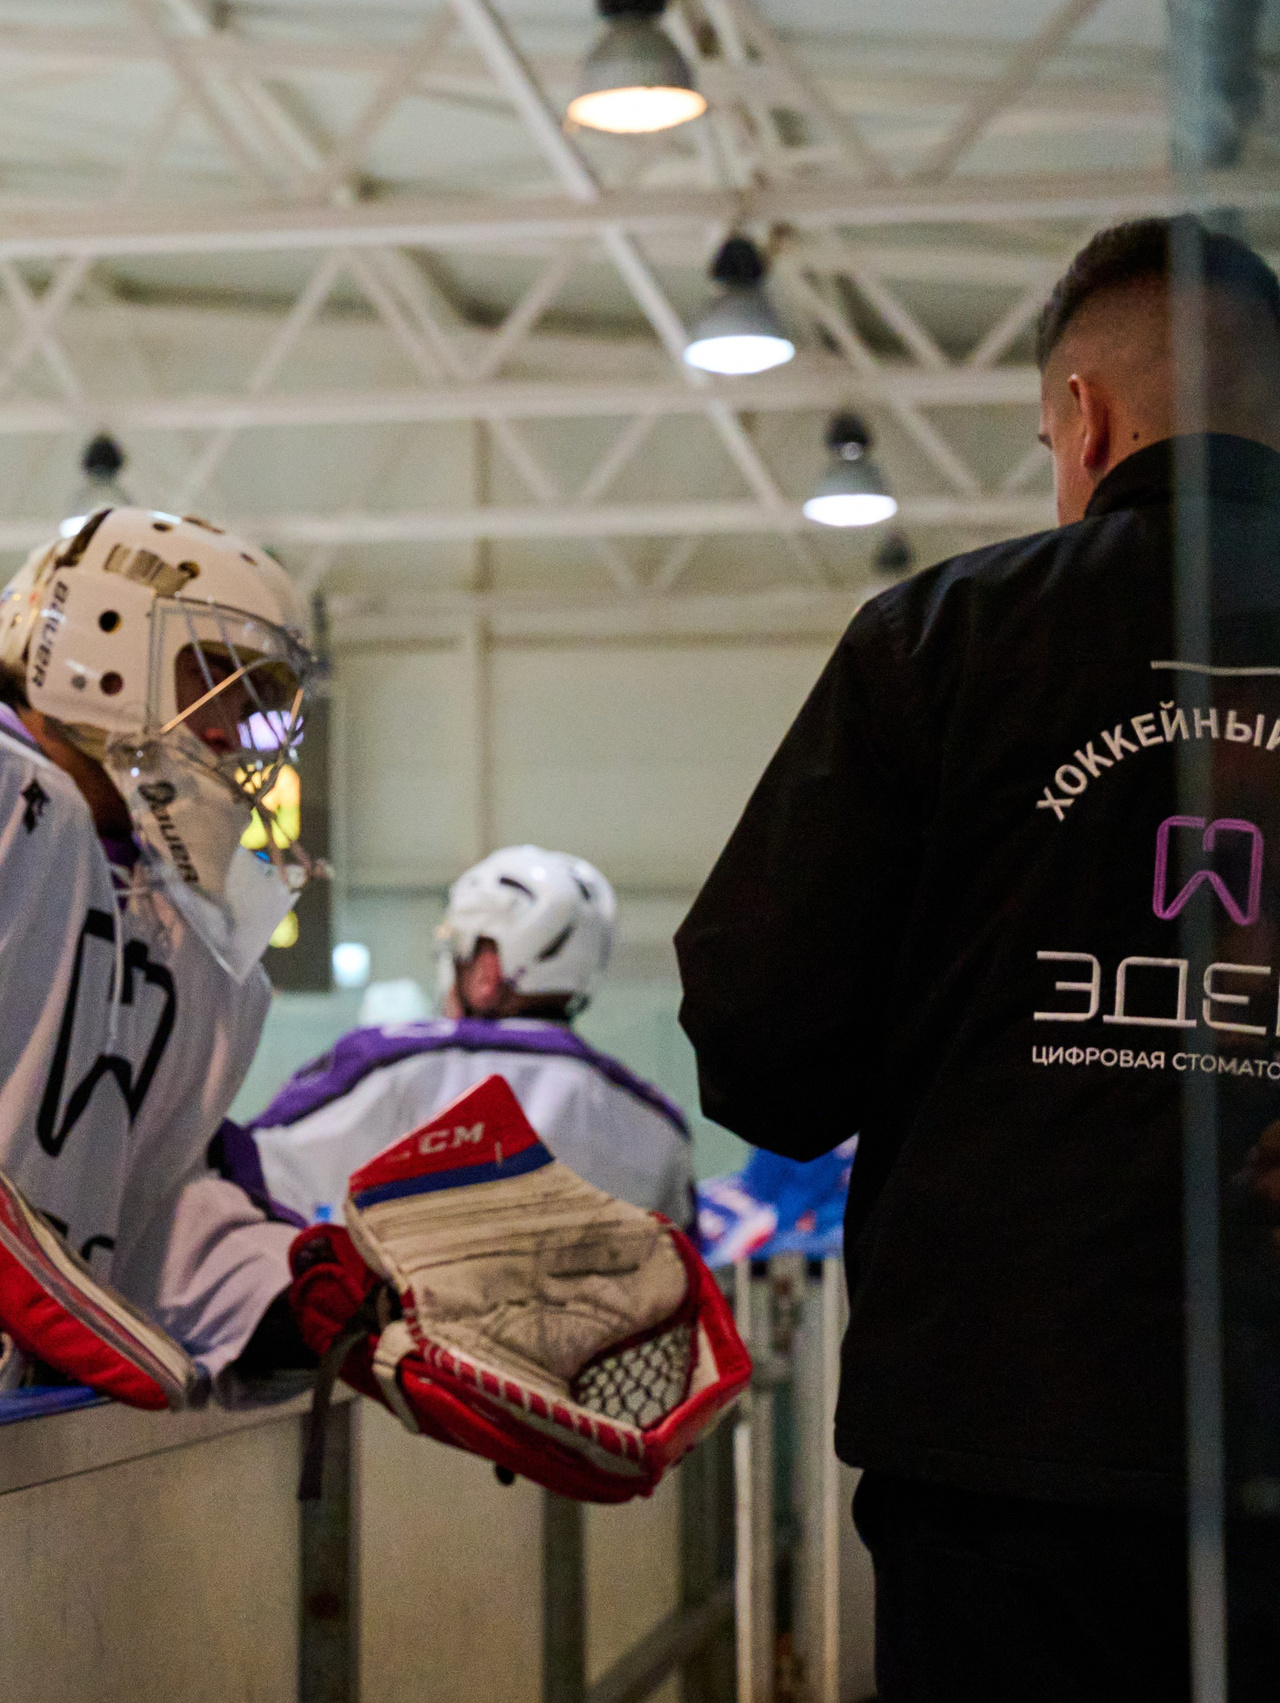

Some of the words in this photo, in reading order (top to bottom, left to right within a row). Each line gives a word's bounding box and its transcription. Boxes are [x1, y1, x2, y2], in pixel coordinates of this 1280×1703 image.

[1033, 950, 1280, 1037] ЭДЕ
[1032, 1045, 1165, 1069] ЦИФРОВАЯ
[387, 1122, 485, 1163] CM
